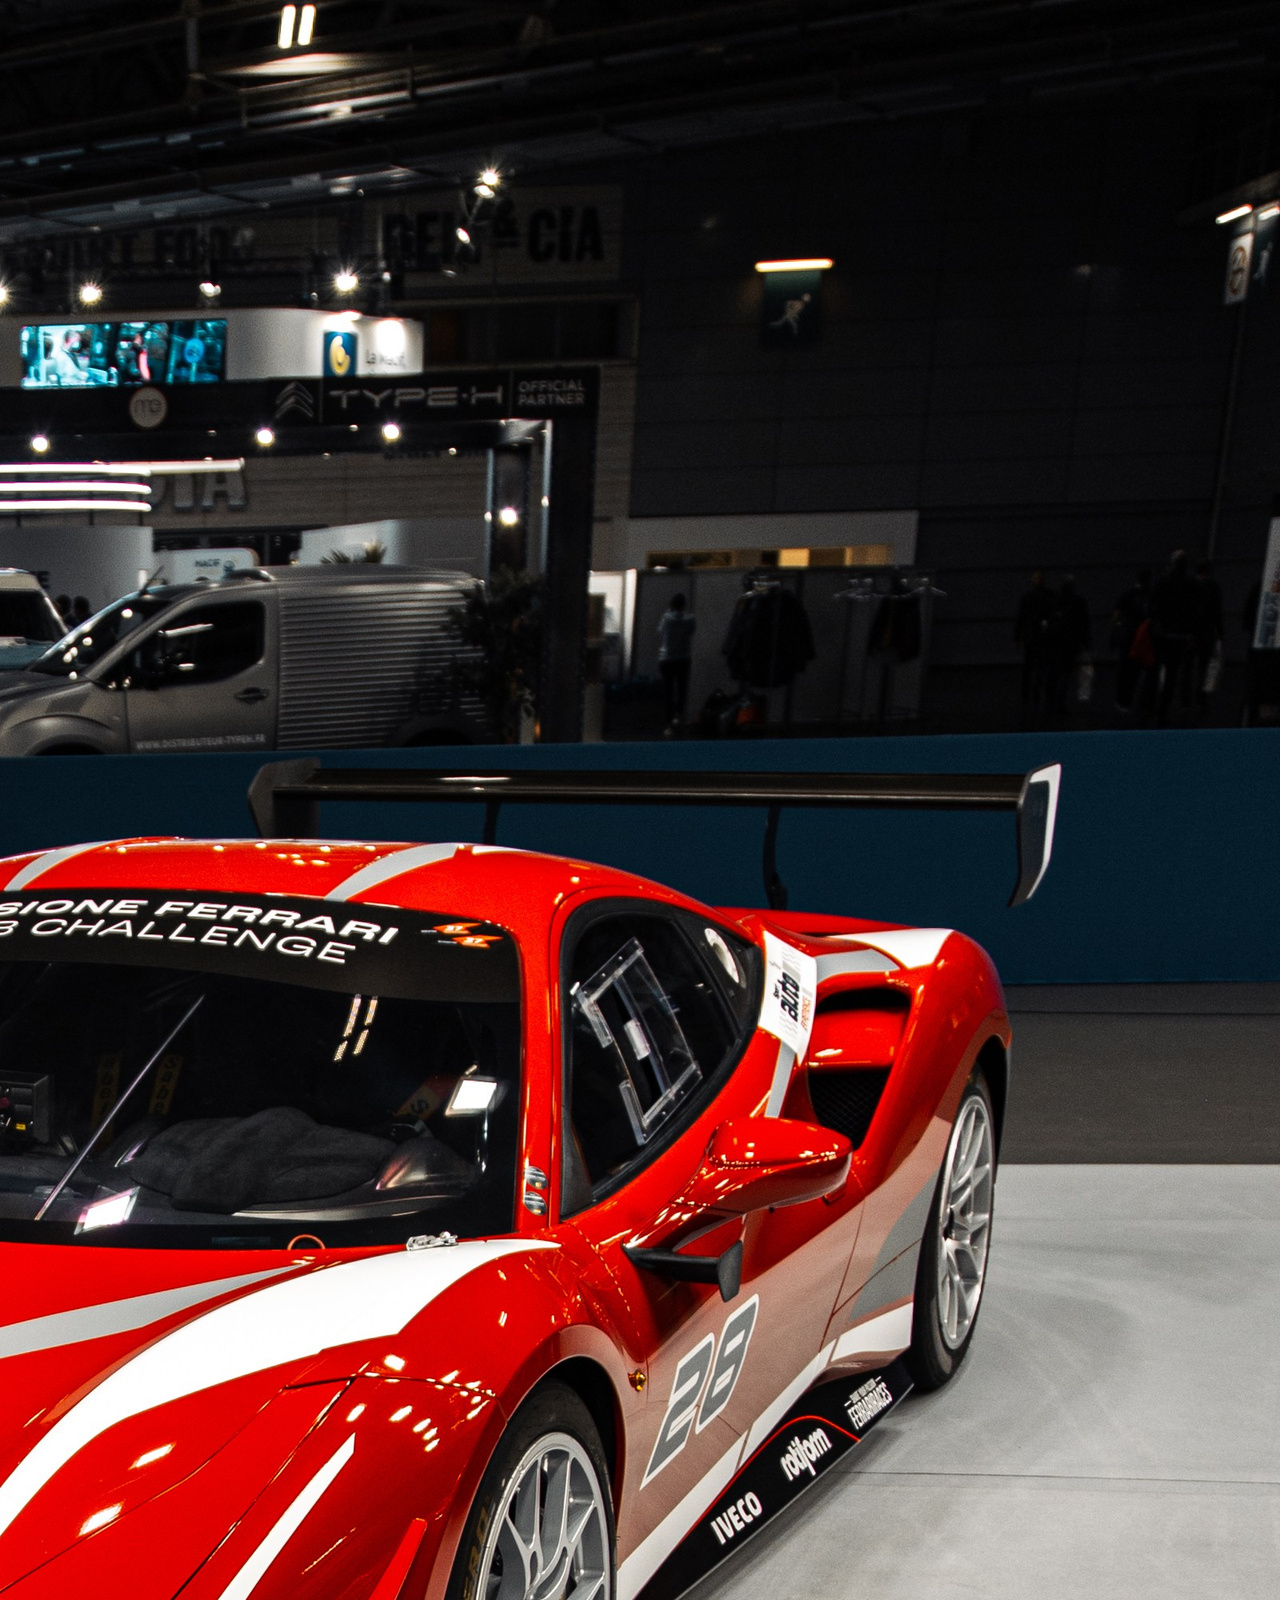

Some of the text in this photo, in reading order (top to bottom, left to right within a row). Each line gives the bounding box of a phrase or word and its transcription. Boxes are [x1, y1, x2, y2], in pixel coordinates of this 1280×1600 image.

[529, 205, 604, 263] CIA
[519, 379, 585, 392] OFFICIAL
[519, 392, 585, 407] PARTNER
[29, 917, 357, 965] CHALLENGE
[153, 900, 399, 945] FERRARI
[777, 971, 801, 1023] auto
[639, 1292, 760, 1491] 28
[780, 1427, 832, 1482] rotiform
[709, 1490, 763, 1546] IVECO
